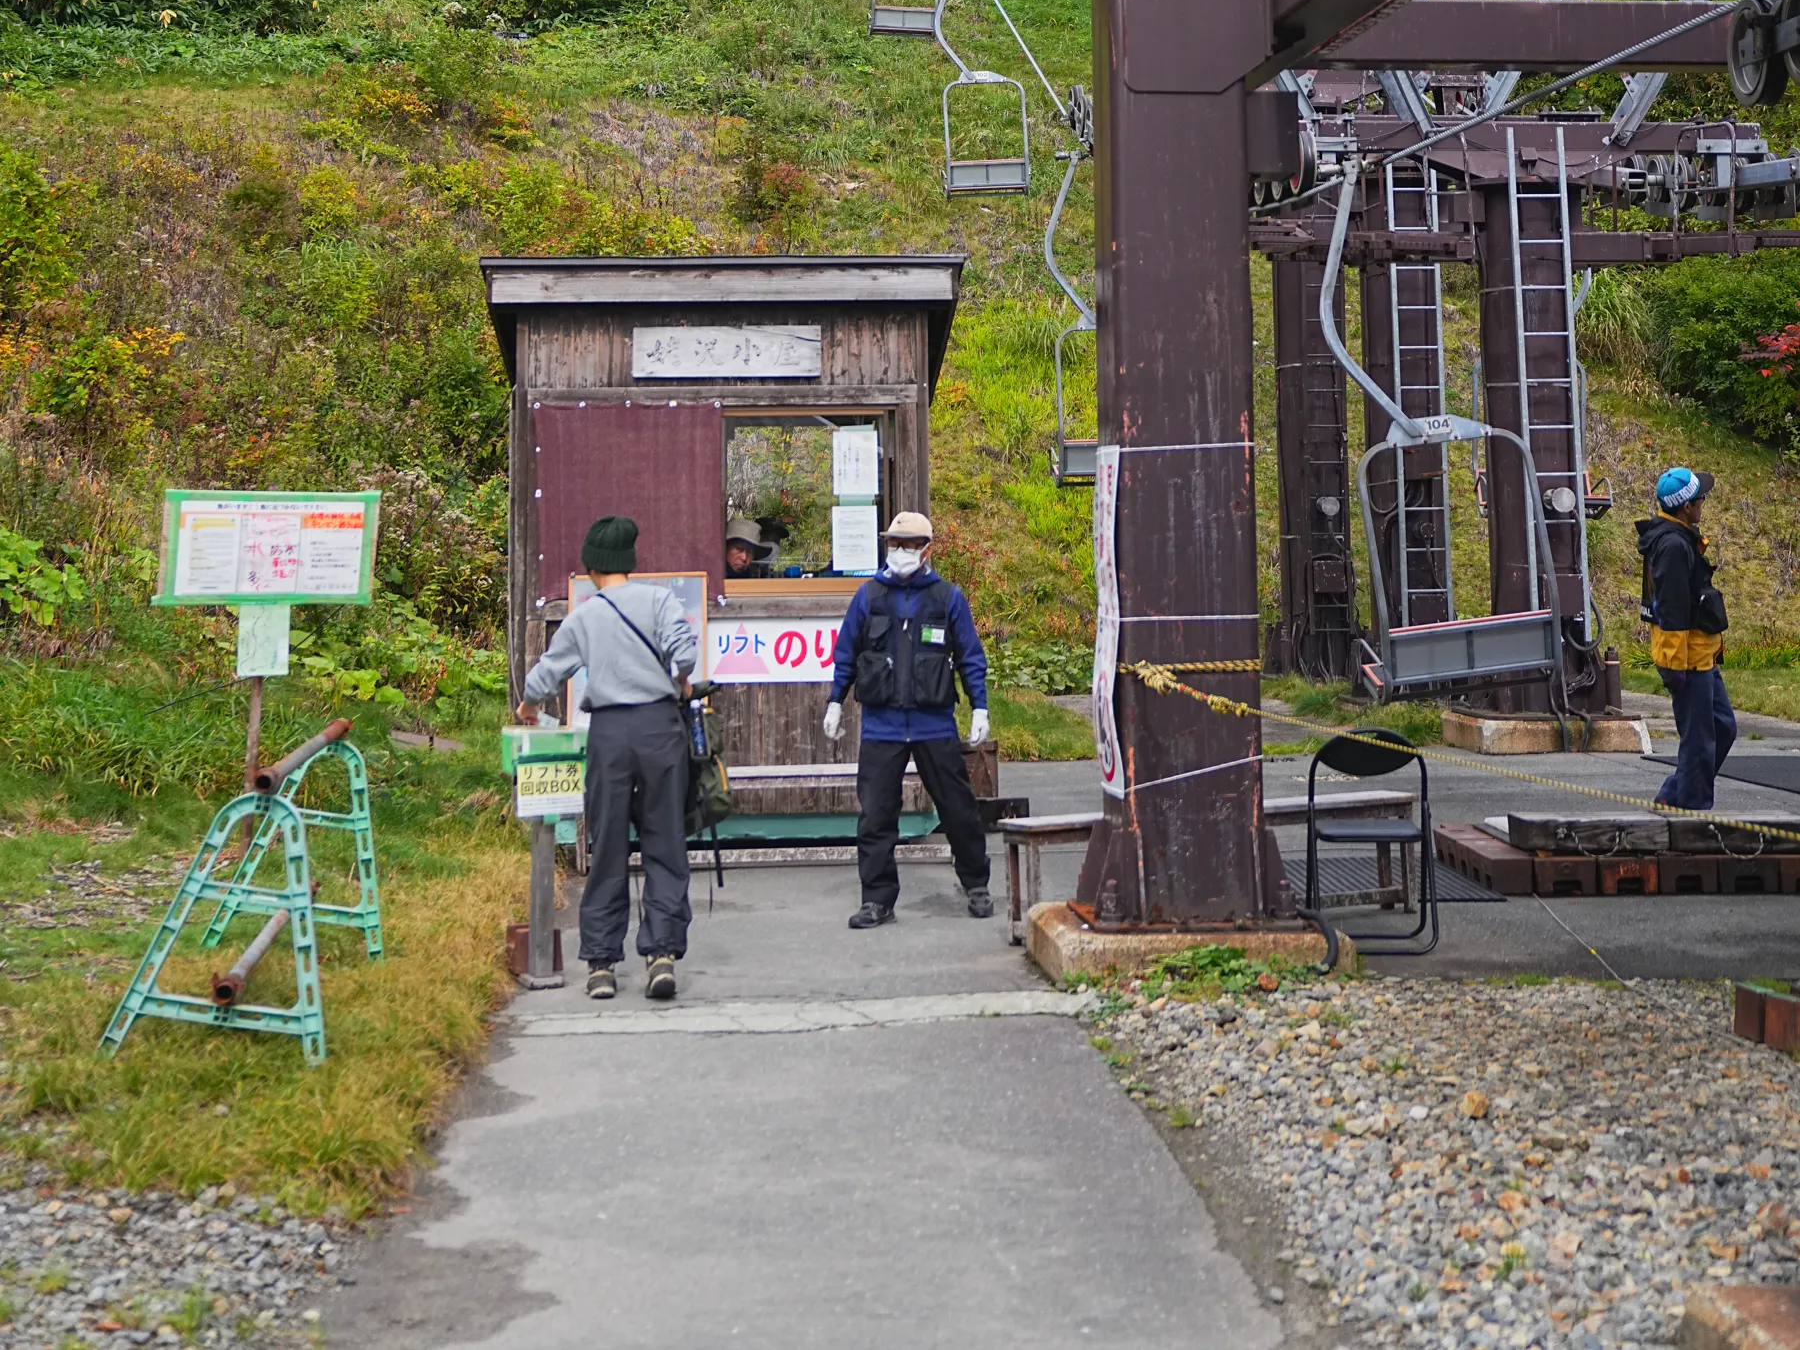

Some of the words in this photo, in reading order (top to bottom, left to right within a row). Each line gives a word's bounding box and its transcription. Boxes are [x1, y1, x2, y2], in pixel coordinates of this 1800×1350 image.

[1426, 418, 1450, 431] 104
[718, 633, 766, 655] リフト
[773, 628, 839, 669] のり
[524, 762, 579, 780] リフト券
[520, 777, 582, 797] 回収BOX
